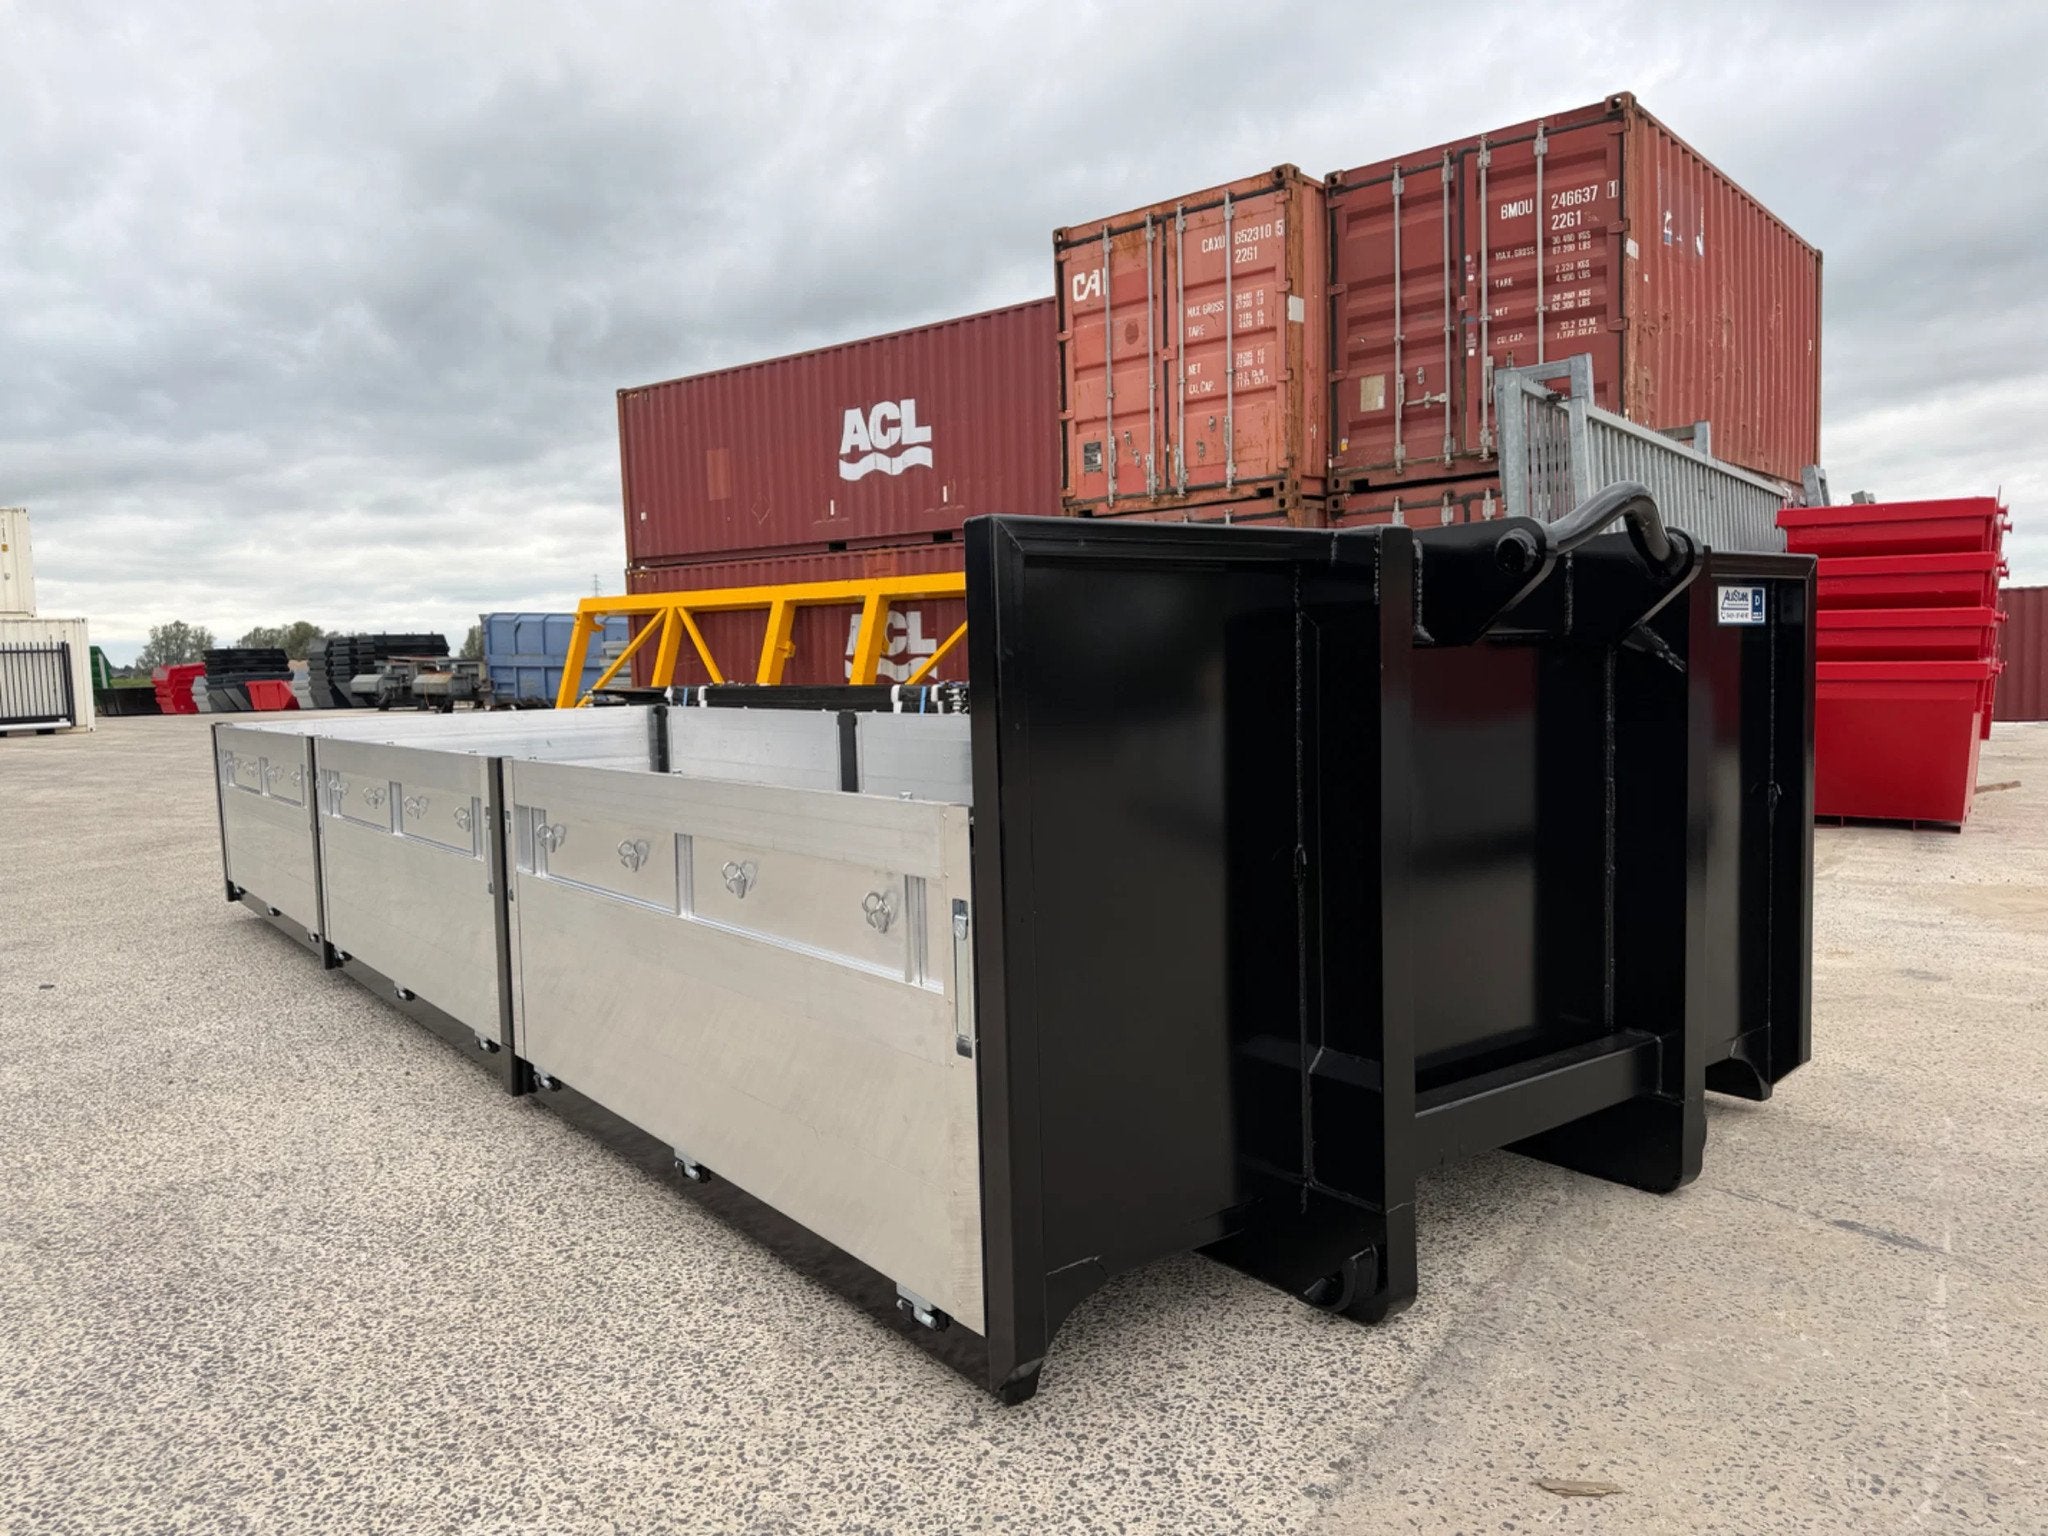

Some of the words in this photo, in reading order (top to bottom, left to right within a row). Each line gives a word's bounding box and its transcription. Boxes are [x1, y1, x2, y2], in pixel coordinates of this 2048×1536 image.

[1500, 199, 1533, 220] BMOU
[1551, 185, 1598, 210] 246637
[1609, 181, 1617, 197] 1
[1201, 233, 1226, 253] CAXU
[1234, 224, 1272, 245] 652310
[1275, 219, 1285, 237] 5
[1551, 210, 1582, 230] 22G1
[839, 398, 932, 455] ACL
